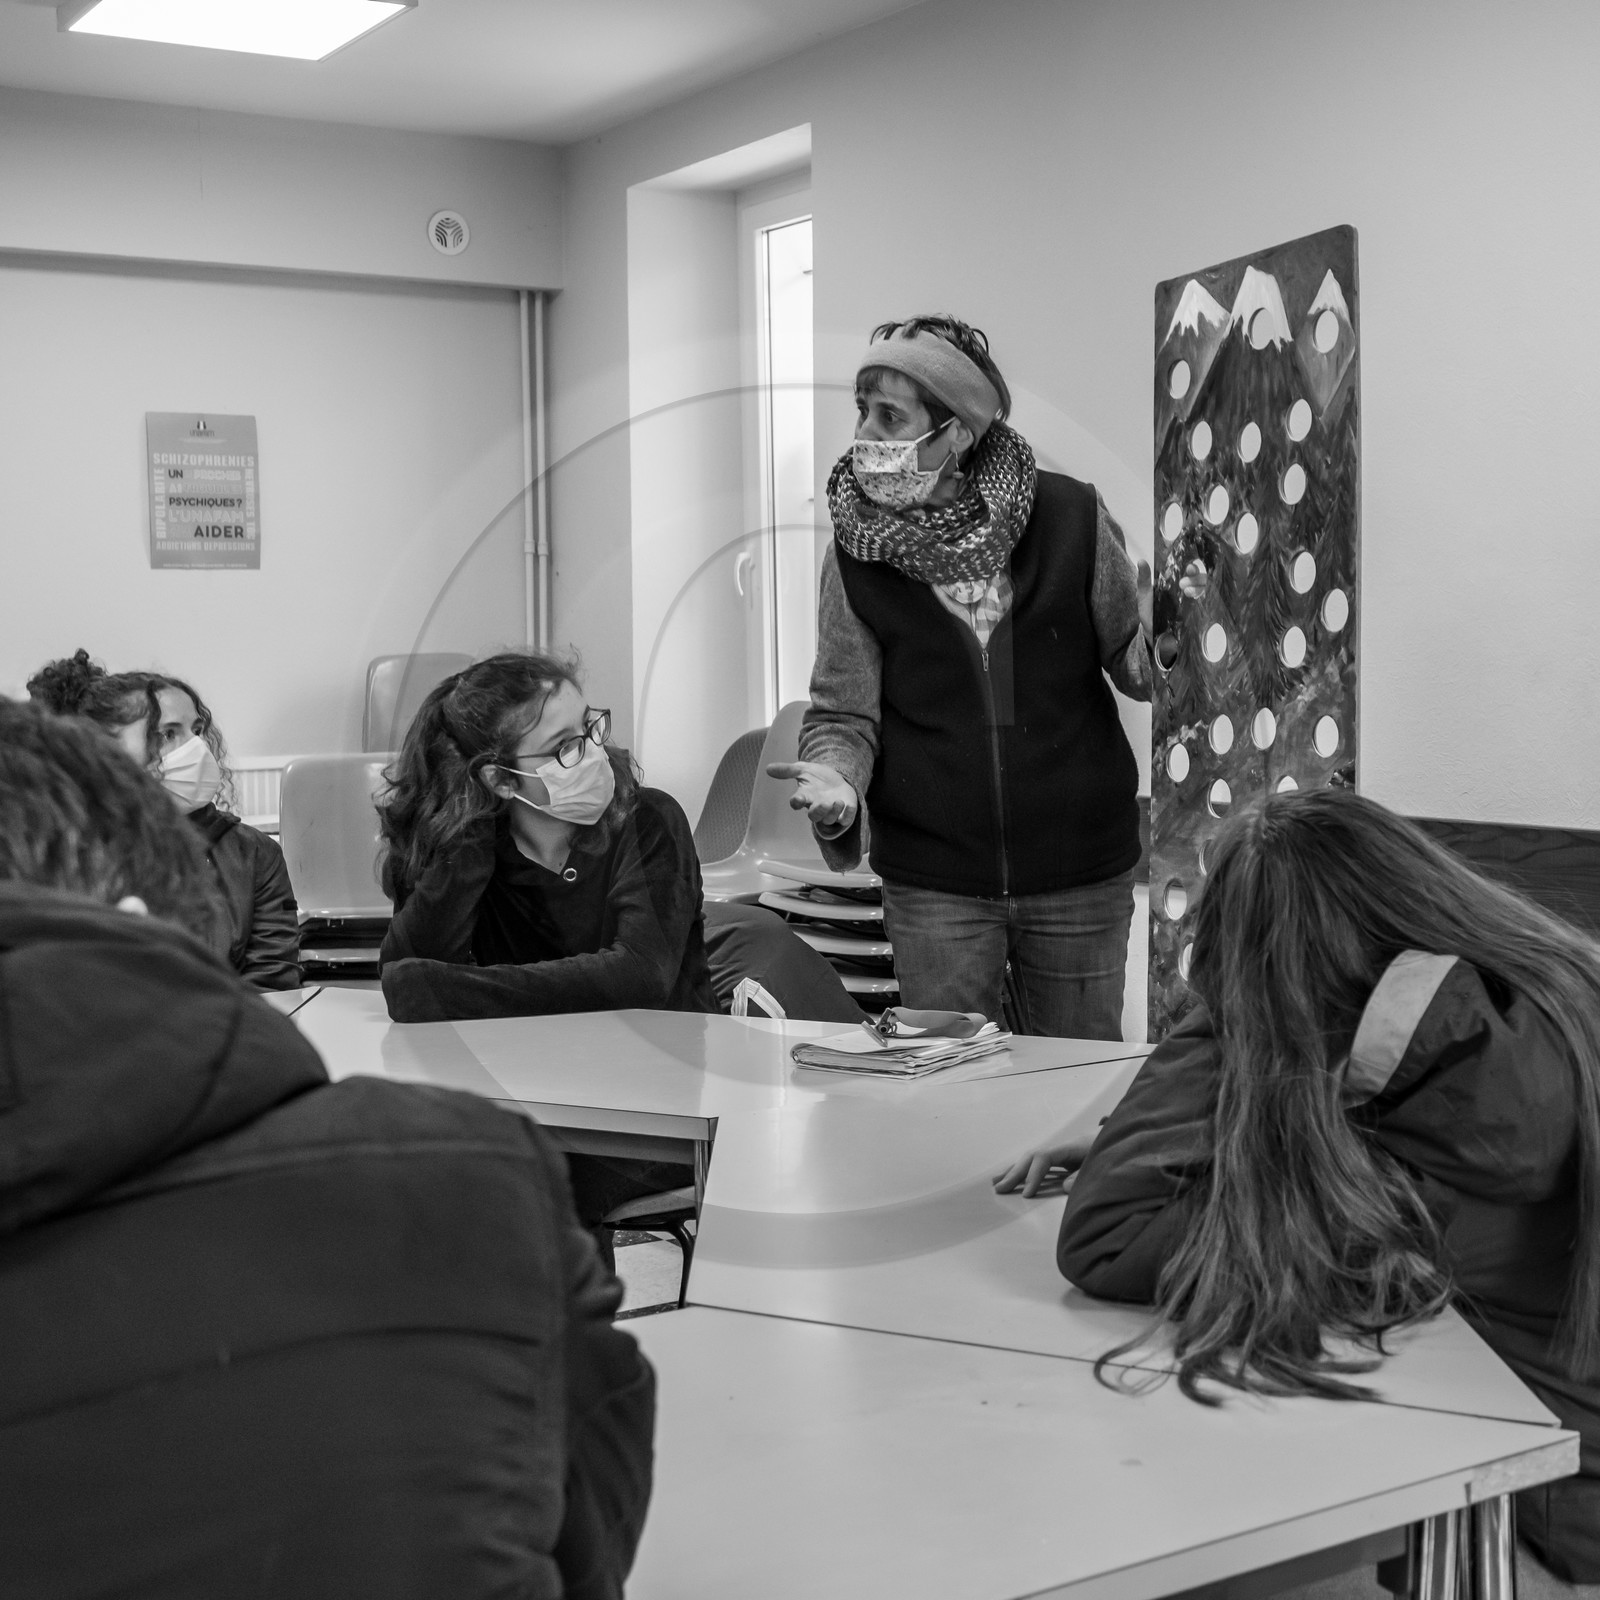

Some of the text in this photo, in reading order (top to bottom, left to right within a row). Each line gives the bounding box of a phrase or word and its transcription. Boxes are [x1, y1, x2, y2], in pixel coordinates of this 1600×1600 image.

[153, 452, 255, 467] SCHIZOPHRENIES
[168, 468, 183, 479] UN
[194, 525, 244, 538] AIDER
